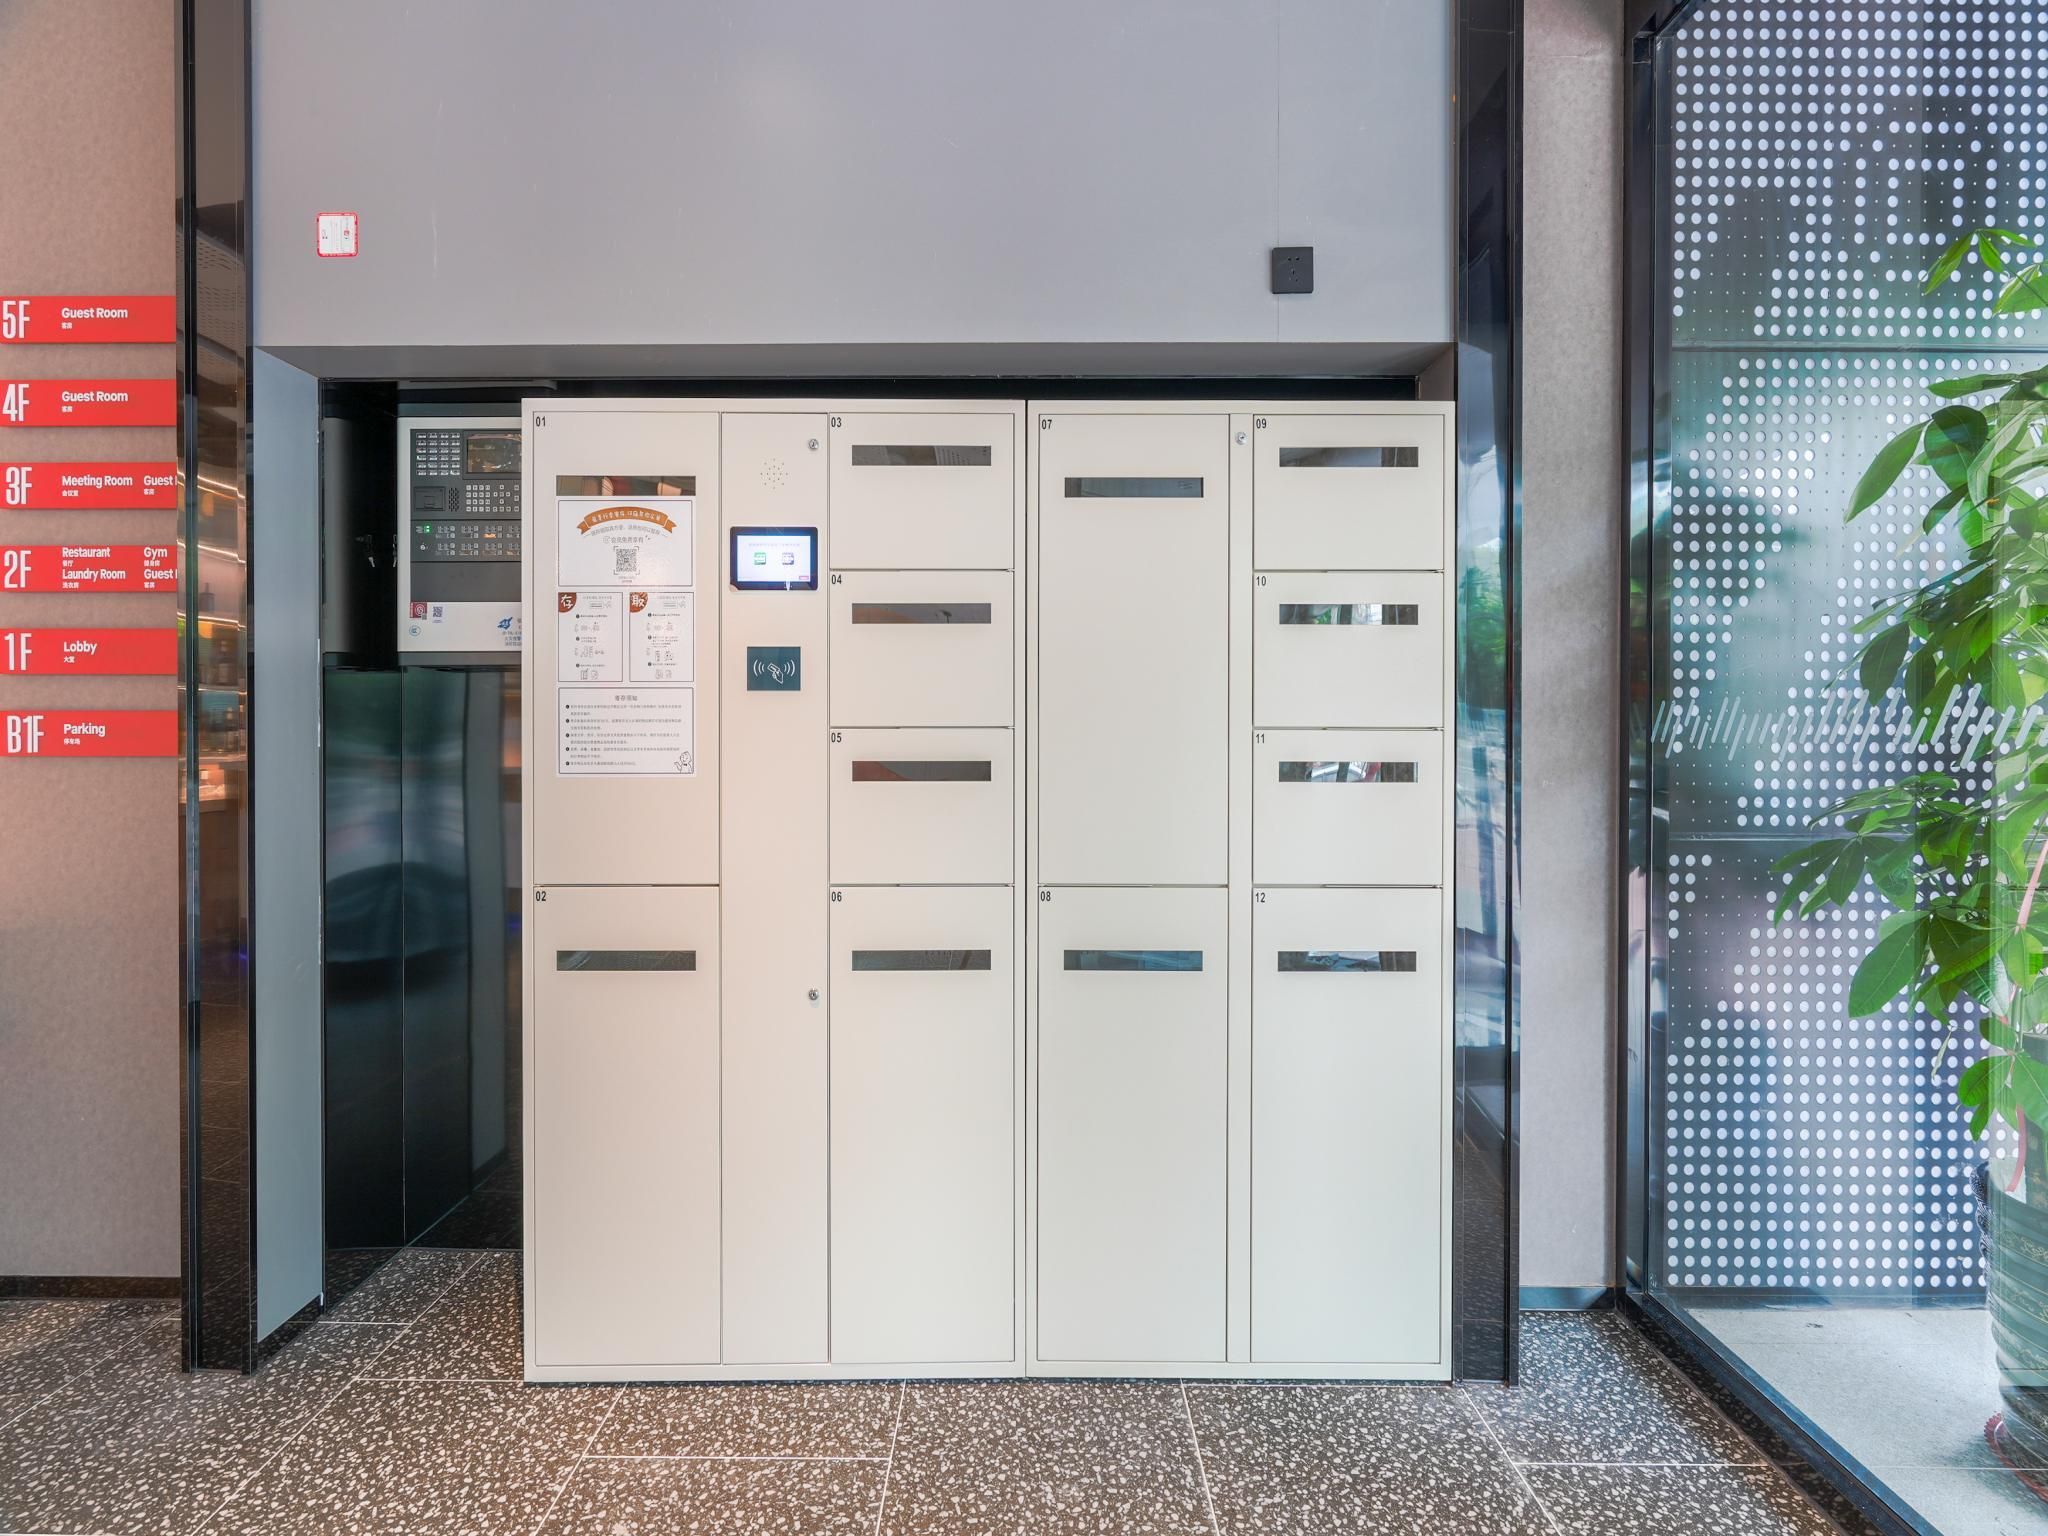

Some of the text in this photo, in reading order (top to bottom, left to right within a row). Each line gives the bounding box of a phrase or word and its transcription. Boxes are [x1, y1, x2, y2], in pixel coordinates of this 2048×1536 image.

[61, 307, 128, 318] Guest Room
[2, 300, 30, 339] 5F
[61, 391, 128, 402] Guest Room
[2, 383, 30, 422] 4F
[535, 416, 546, 427] 01
[831, 417, 842, 428] 03
[1041, 419, 1052, 430] 07
[1256, 418, 1267, 429] 09
[5, 467, 32, 505] 3F
[61, 475, 133, 488] Meeting Room
[143, 475, 175, 486] Guest
[62, 547, 111, 558] Restaurant
[143, 547, 168, 560] Gym
[4, 550, 32, 589] 2F
[62, 568, 126, 582] Laundry Room
[144, 569, 174, 580] Guest
[831, 574, 842, 585] 04
[1256, 575, 1267, 586] 10
[4, 633, 32, 671] 1F
[63, 641, 97, 655] Lobby
[7, 715, 44, 753] B1F
[63, 723, 106, 737] Parking
[831, 732, 842, 743] 05
[1255, 733, 1265, 744] 11
[535, 891, 546, 902] 02
[831, 891, 842, 902] 06
[1040, 891, 1051, 902] 08
[1255, 892, 1266, 903] 12
